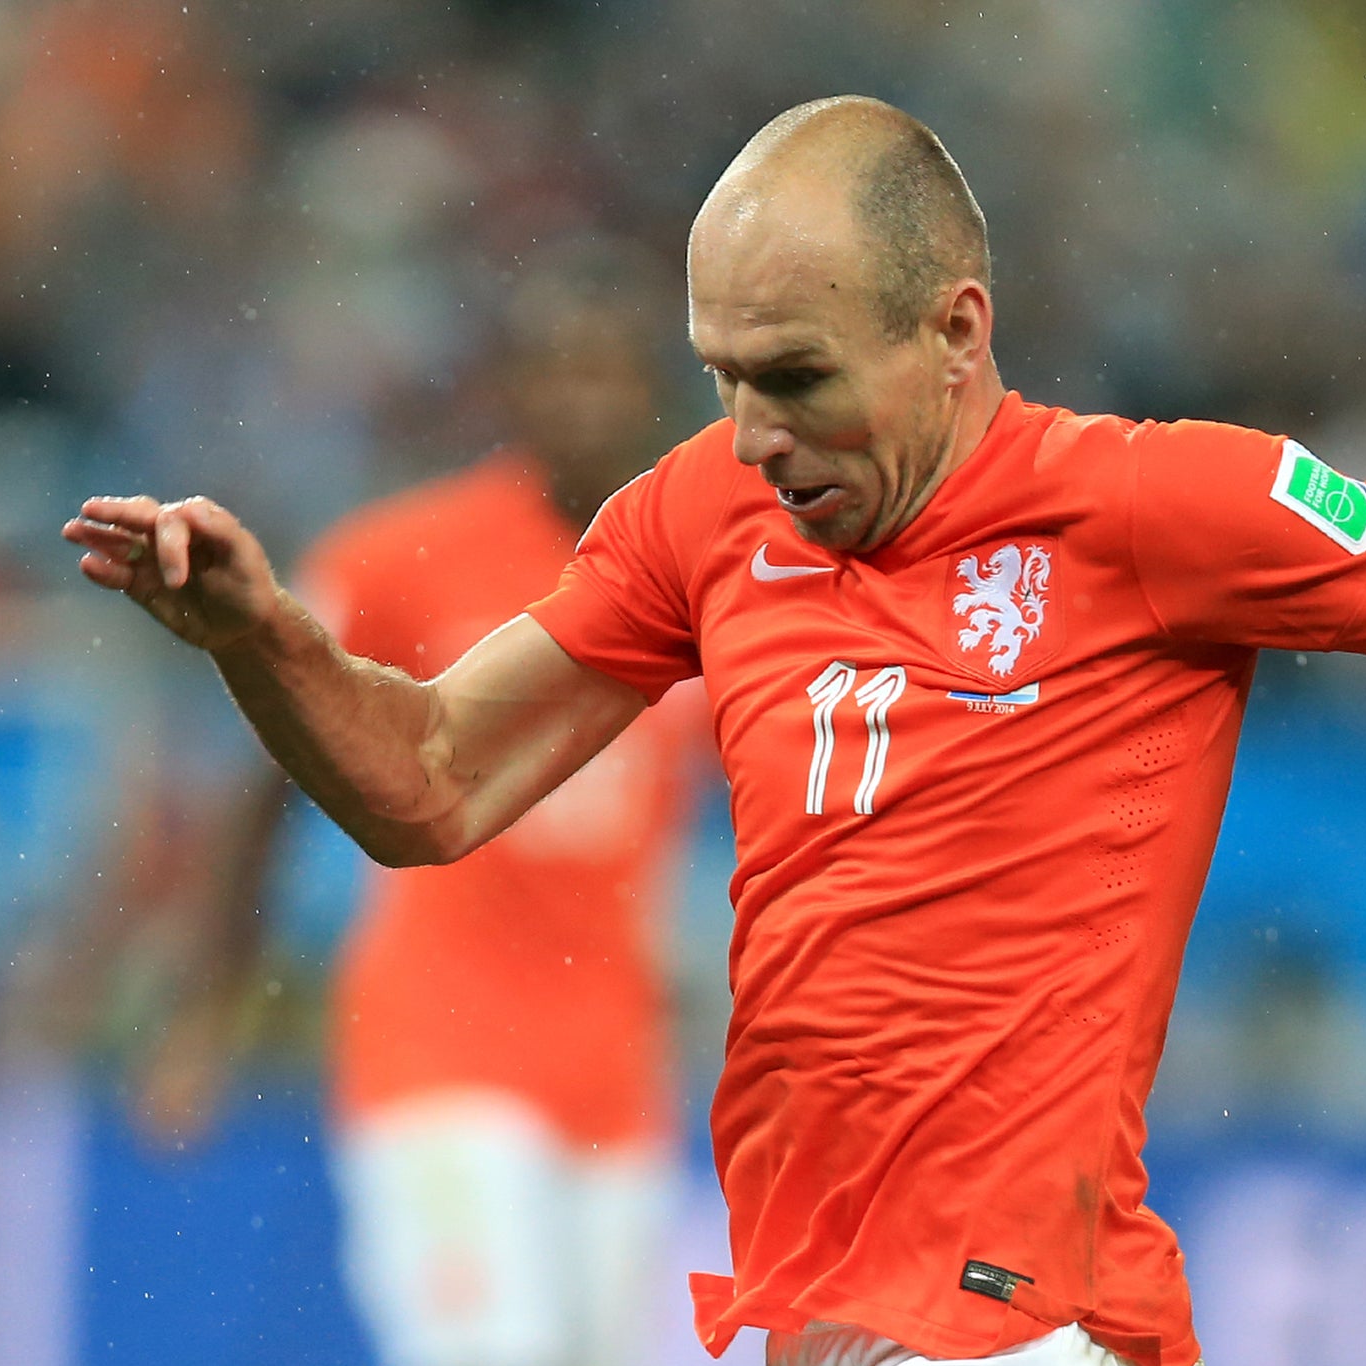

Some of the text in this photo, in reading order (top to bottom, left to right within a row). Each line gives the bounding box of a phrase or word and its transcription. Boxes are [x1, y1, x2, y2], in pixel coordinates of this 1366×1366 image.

[805, 660, 907, 815] 11
[966, 701, 1015, 714] 9 JULY 2014
